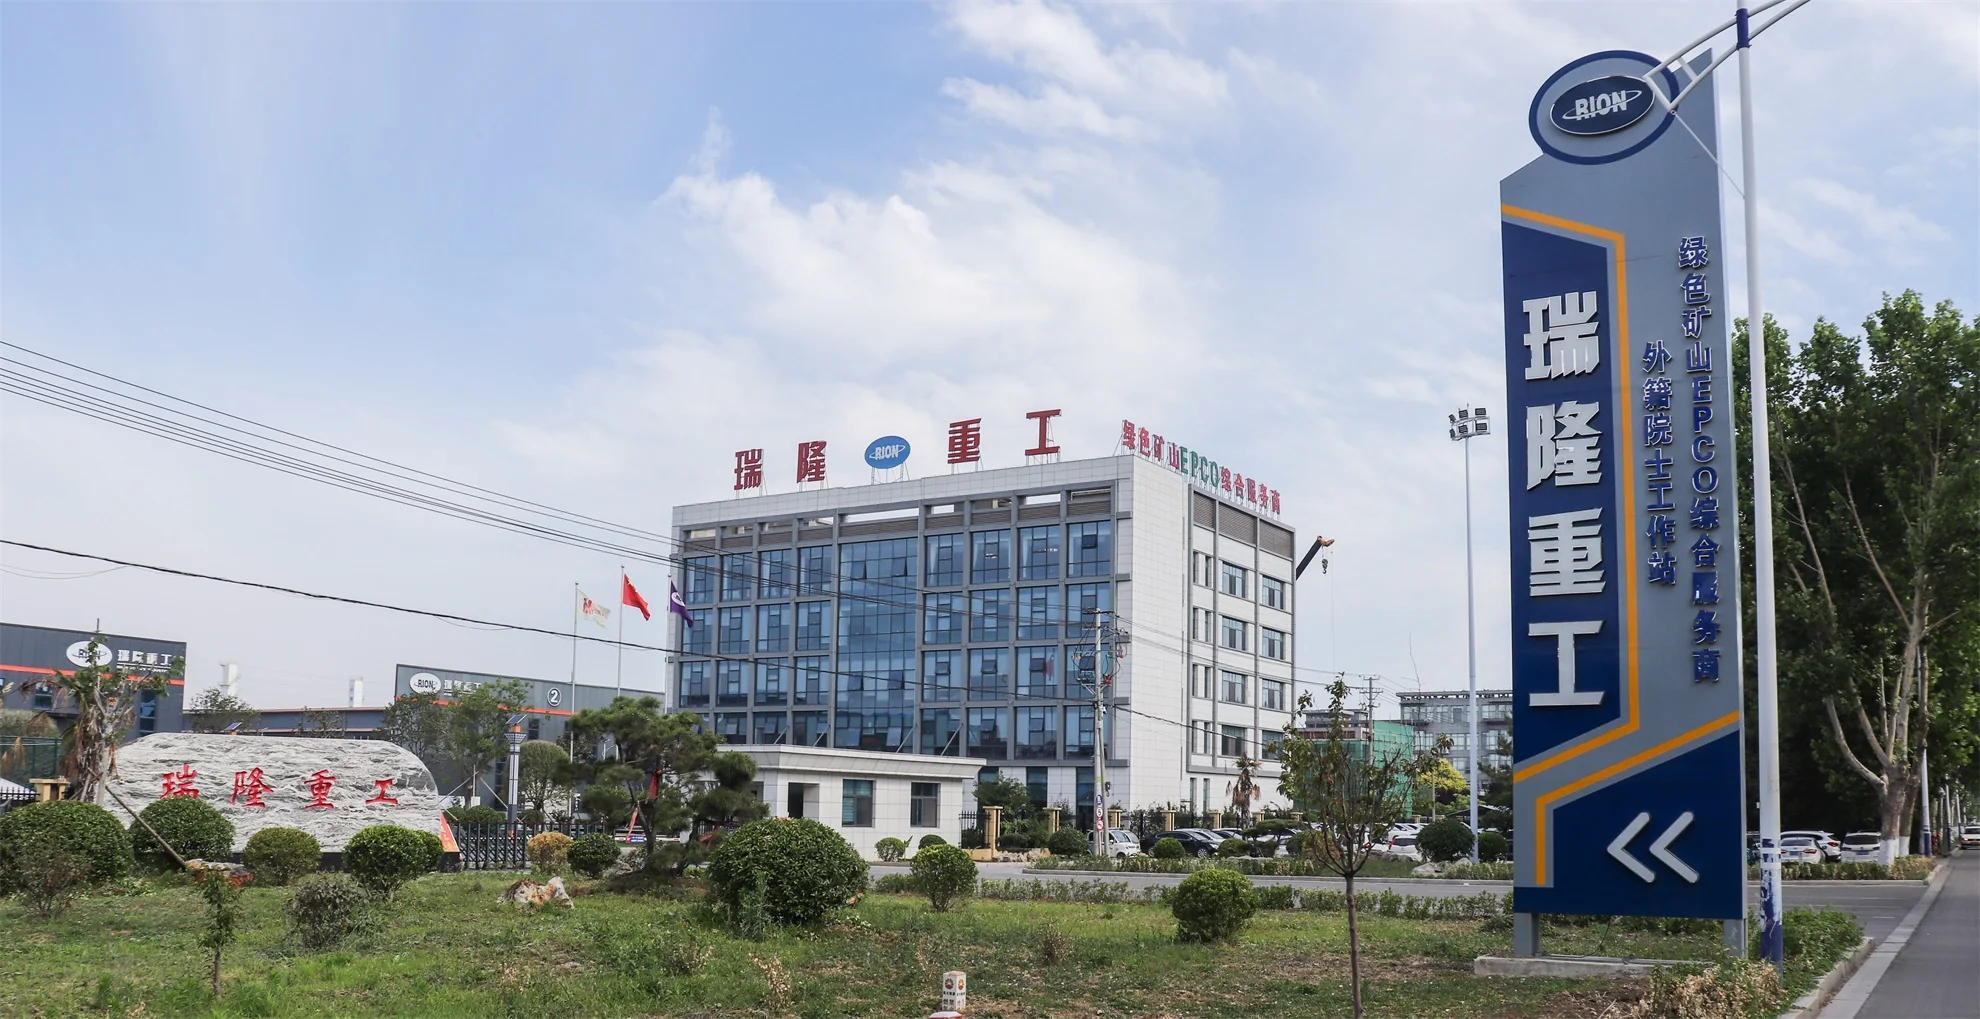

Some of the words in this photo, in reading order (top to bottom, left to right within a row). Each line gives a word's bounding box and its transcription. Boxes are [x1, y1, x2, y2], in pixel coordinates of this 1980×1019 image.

[1575, 90, 1627, 120] RION
[874, 444, 899, 460] RION
[1122, 419, 1281, 515] 绿色矿山EPCO综合服务商
[1522, 291, 1606, 707] 瑞隆重工
[1642, 339, 1677, 586] 外籍院士工作站
[1678, 236, 1722, 684] 绿色矿山EPCO综合服务商
[160, 762, 399, 810] 瑞隆重工
